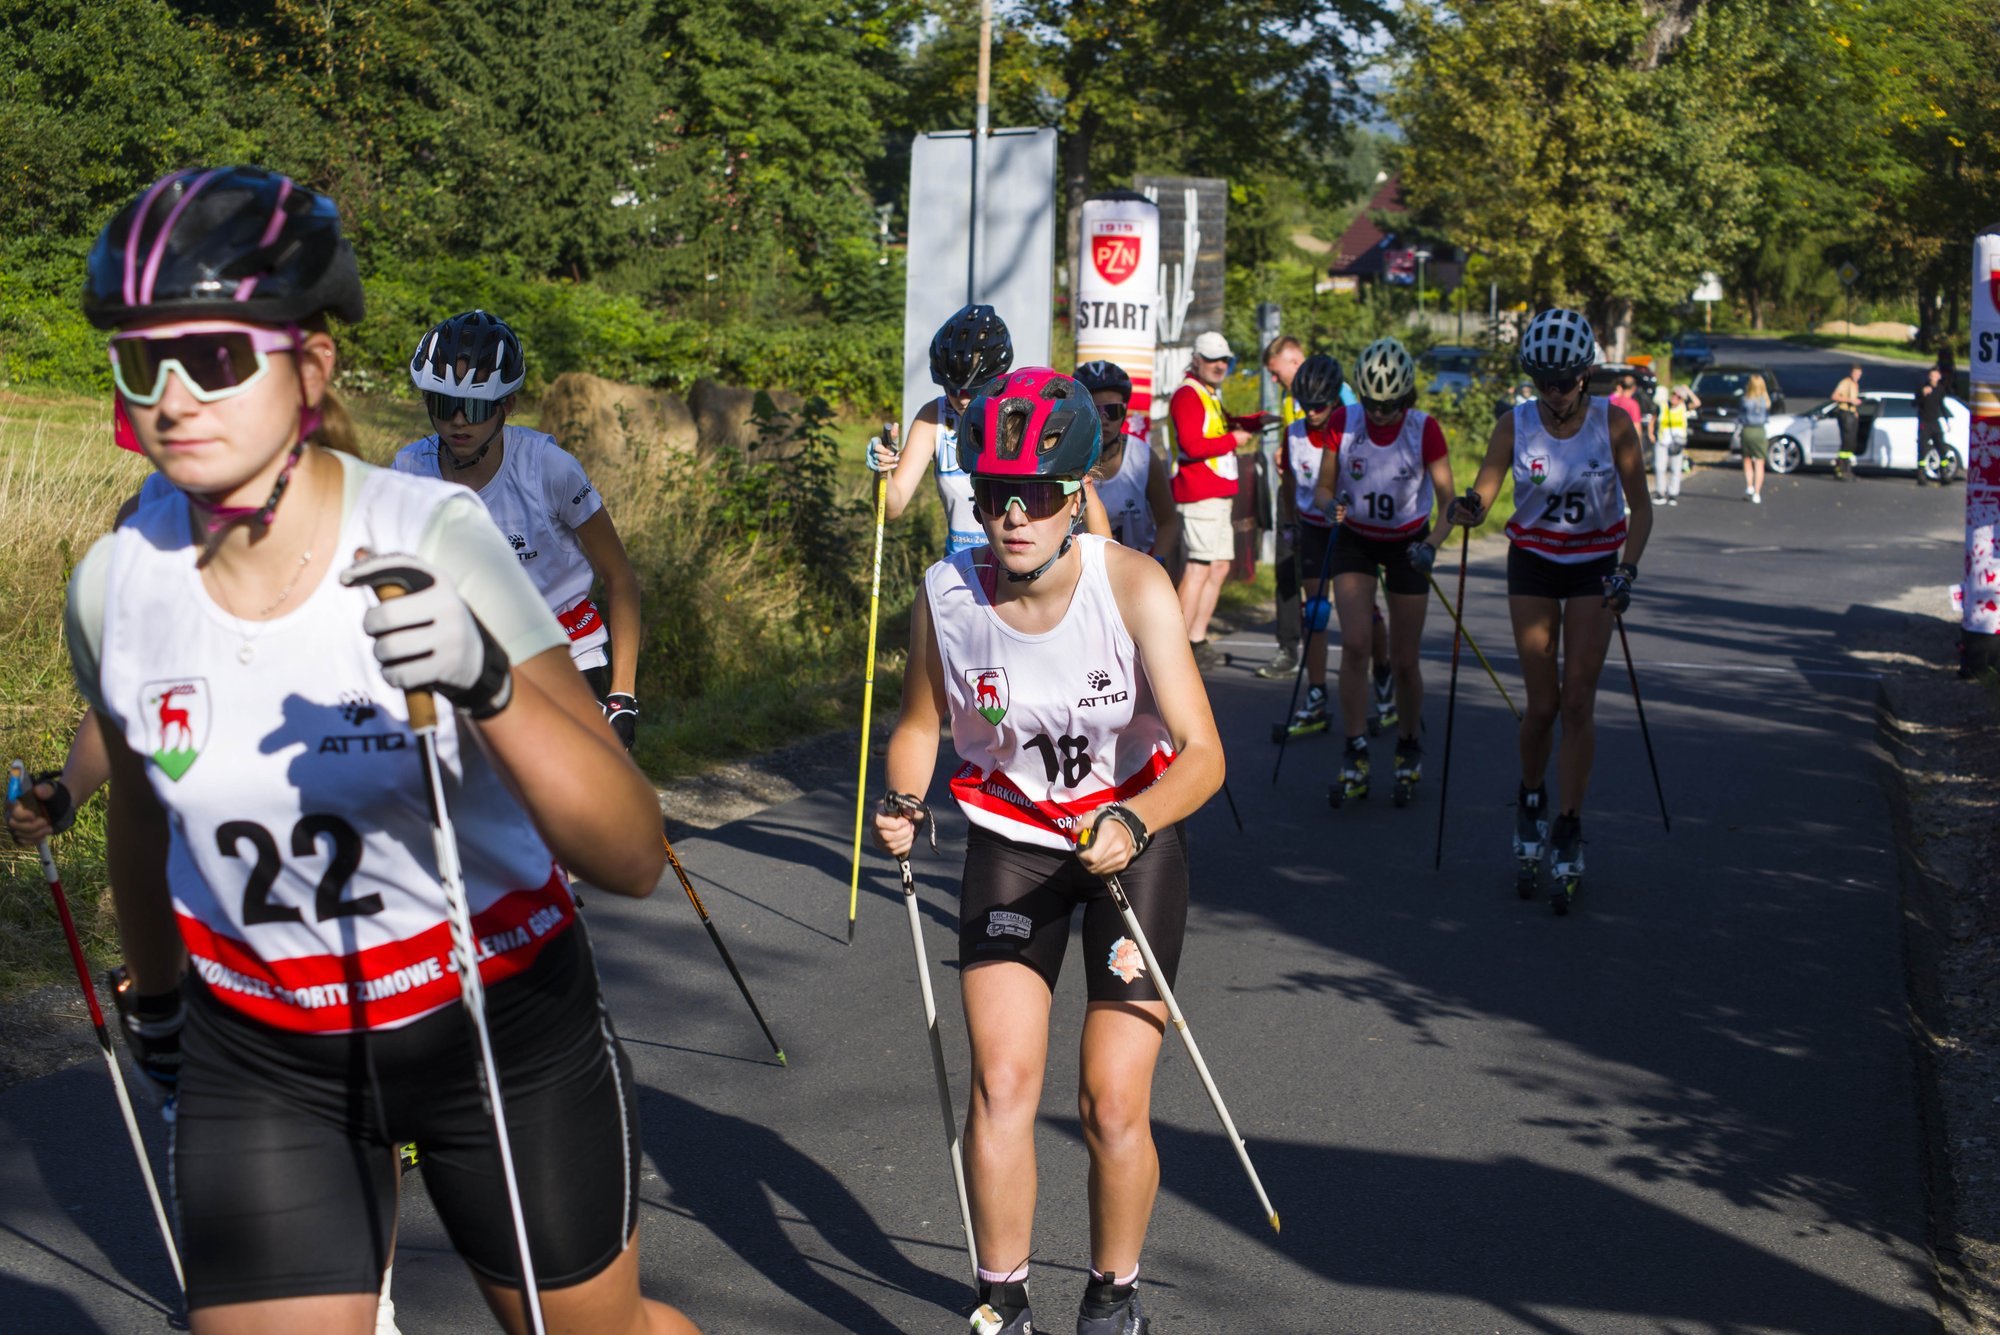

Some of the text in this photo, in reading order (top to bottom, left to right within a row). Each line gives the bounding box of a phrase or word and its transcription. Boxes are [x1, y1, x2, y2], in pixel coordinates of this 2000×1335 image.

[1096, 240, 1137, 275] PZN
[1079, 301, 1150, 331] START
[1362, 491, 1395, 521] 19
[1541, 492, 1586, 525] 25
[1077, 690, 1129, 708] ATTIQ
[318, 733, 406, 755] ATTIQ
[1022, 733, 1092, 789] 18
[215, 814, 385, 926] 22
[355, 955, 444, 1003] ZIMOWE
[446, 926, 532, 974] JLENIA
